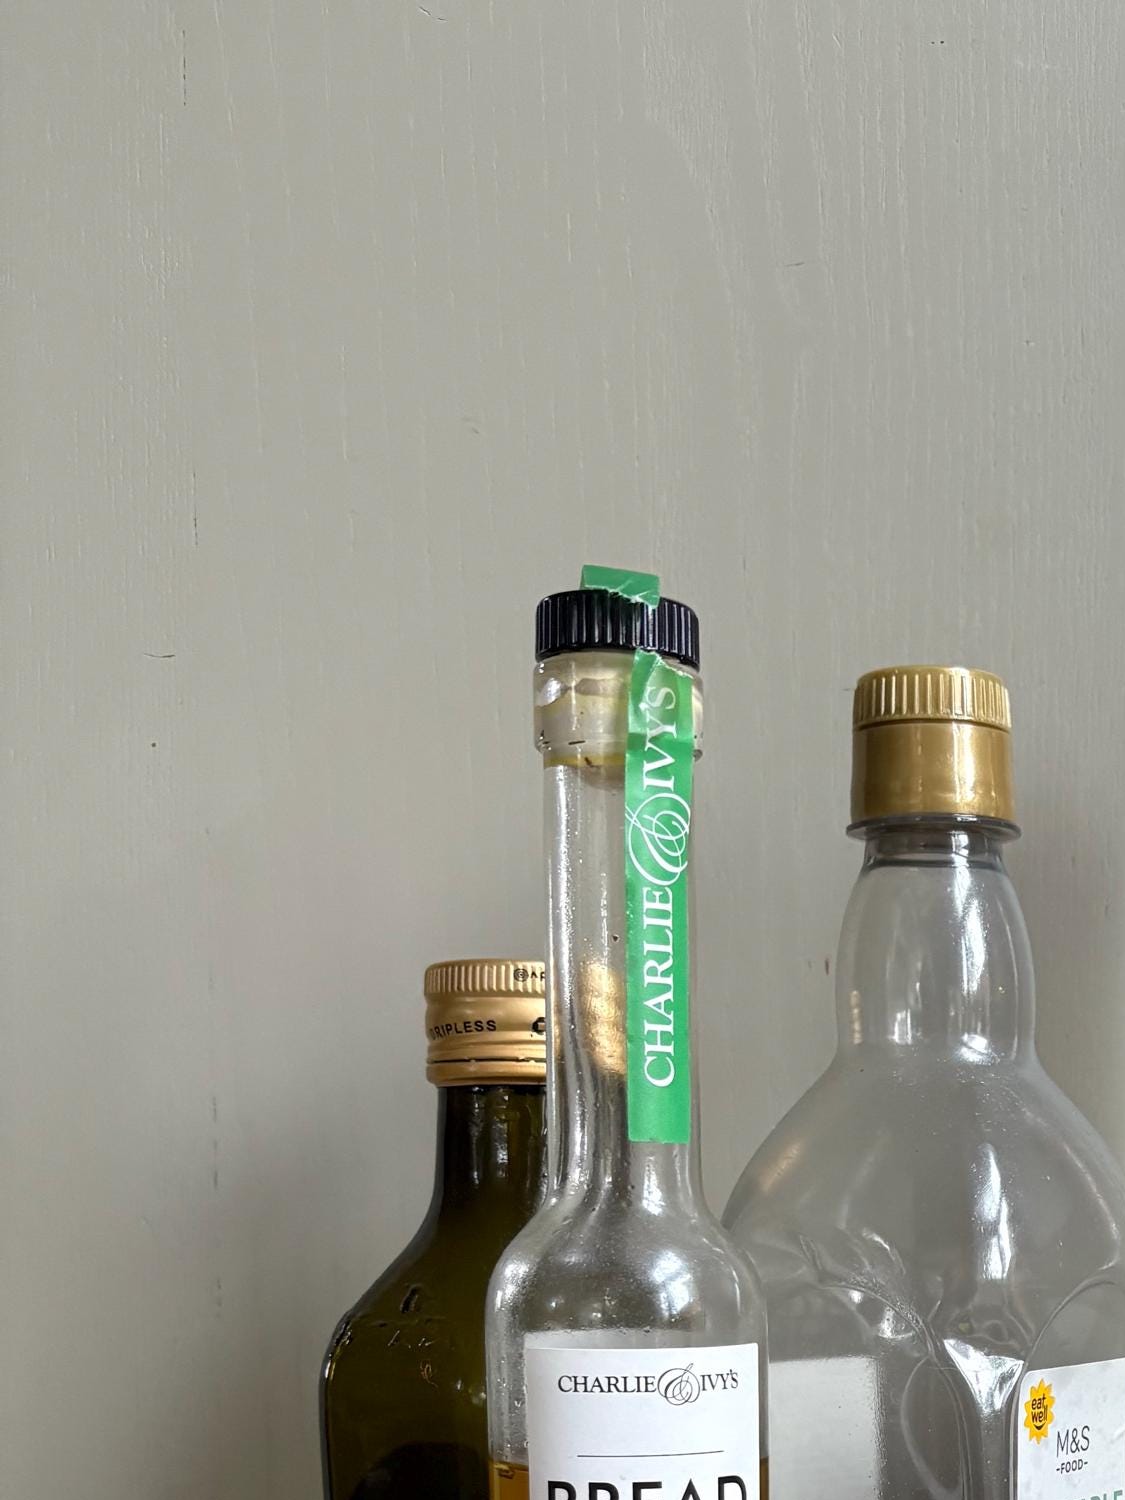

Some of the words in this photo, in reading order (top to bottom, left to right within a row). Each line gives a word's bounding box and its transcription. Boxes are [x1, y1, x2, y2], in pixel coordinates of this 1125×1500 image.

[640, 686, 678, 791] IVY'S
[625, 792, 691, 886] &
[643, 887, 676, 1087] CHARLIE
[557, 1375, 656, 1393] CHARLIE
[657, 1362, 700, 1406] &
[701, 1368, 739, 1392] IVY'S
[1031, 1393, 1047, 1410] eat
[1031, 1404, 1048, 1423] well
[1056, 1425, 1090, 1458] M&S
